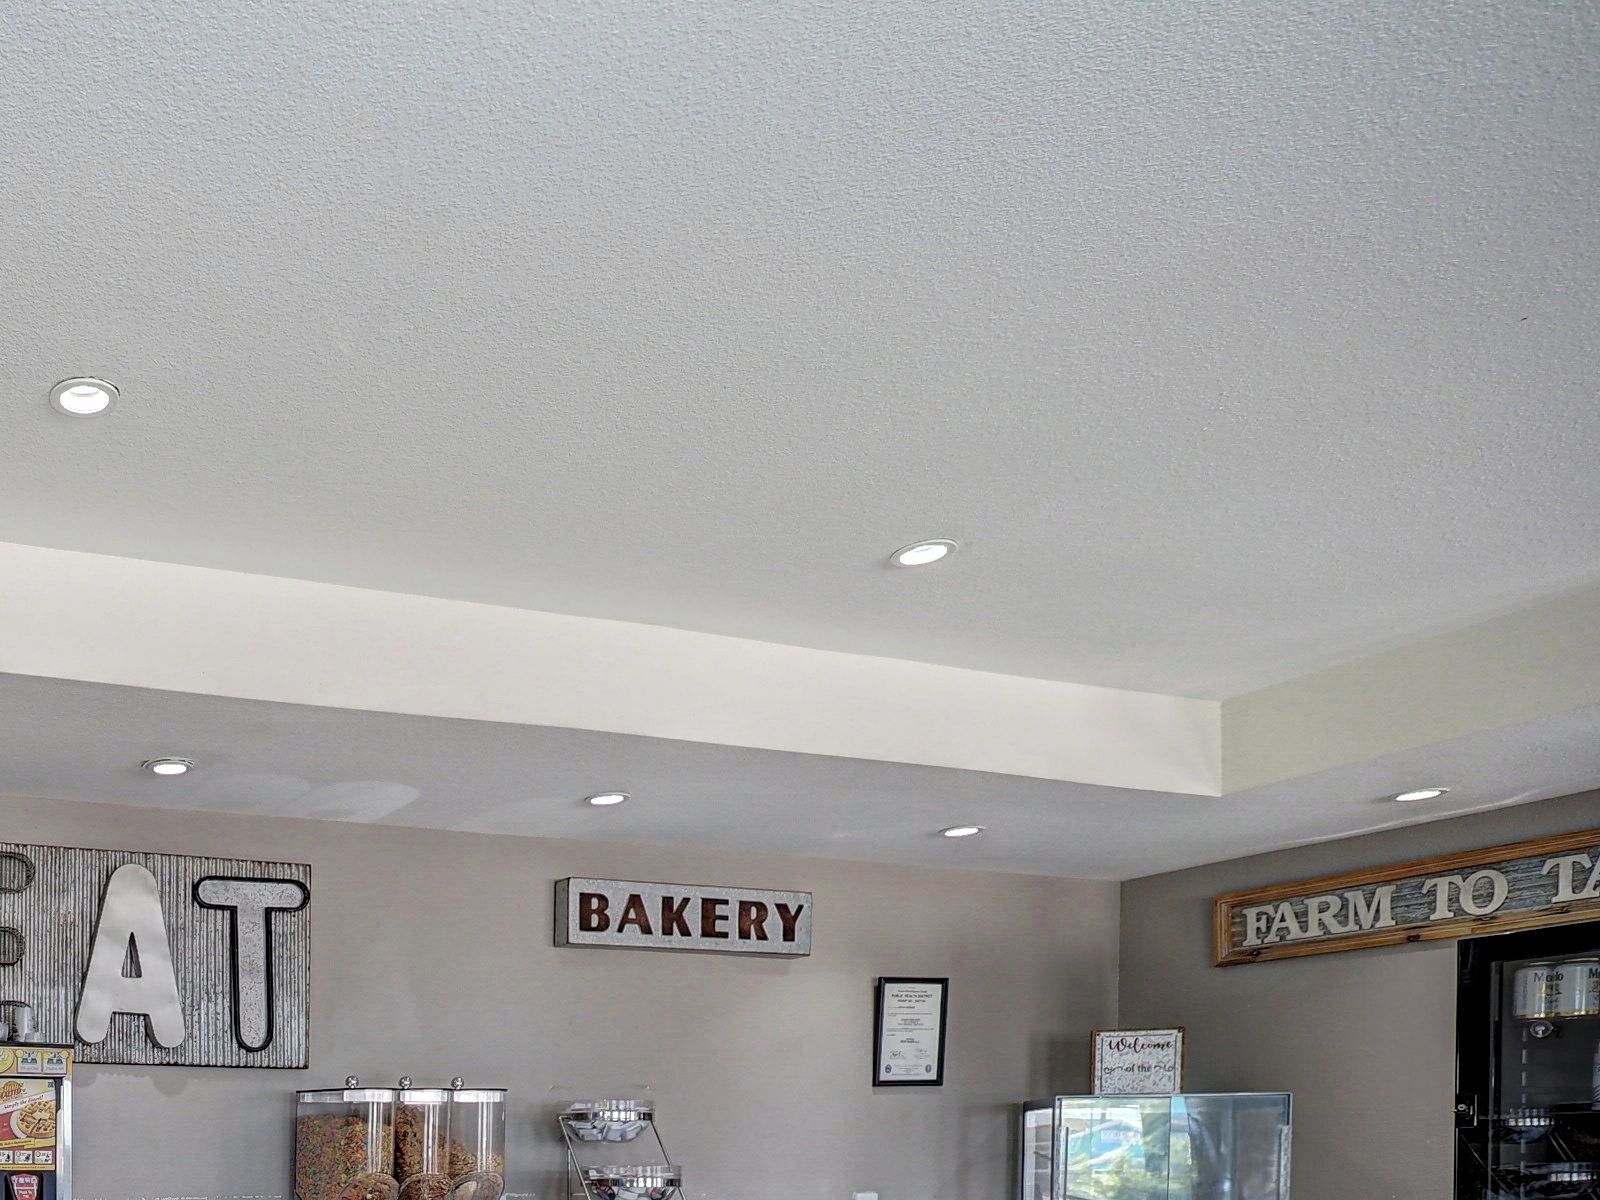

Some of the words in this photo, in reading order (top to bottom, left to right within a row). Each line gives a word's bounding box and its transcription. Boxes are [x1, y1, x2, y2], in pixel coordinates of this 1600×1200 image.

[578, 891, 805, 943] BAKERY
[1241, 883, 1398, 948] FARM
[1421, 868, 1510, 922] TO
[1106, 1037, 1174, 1054] Welcome
[1123, 1063, 1135, 1073] of
[1137, 1063, 1152, 1073] the
